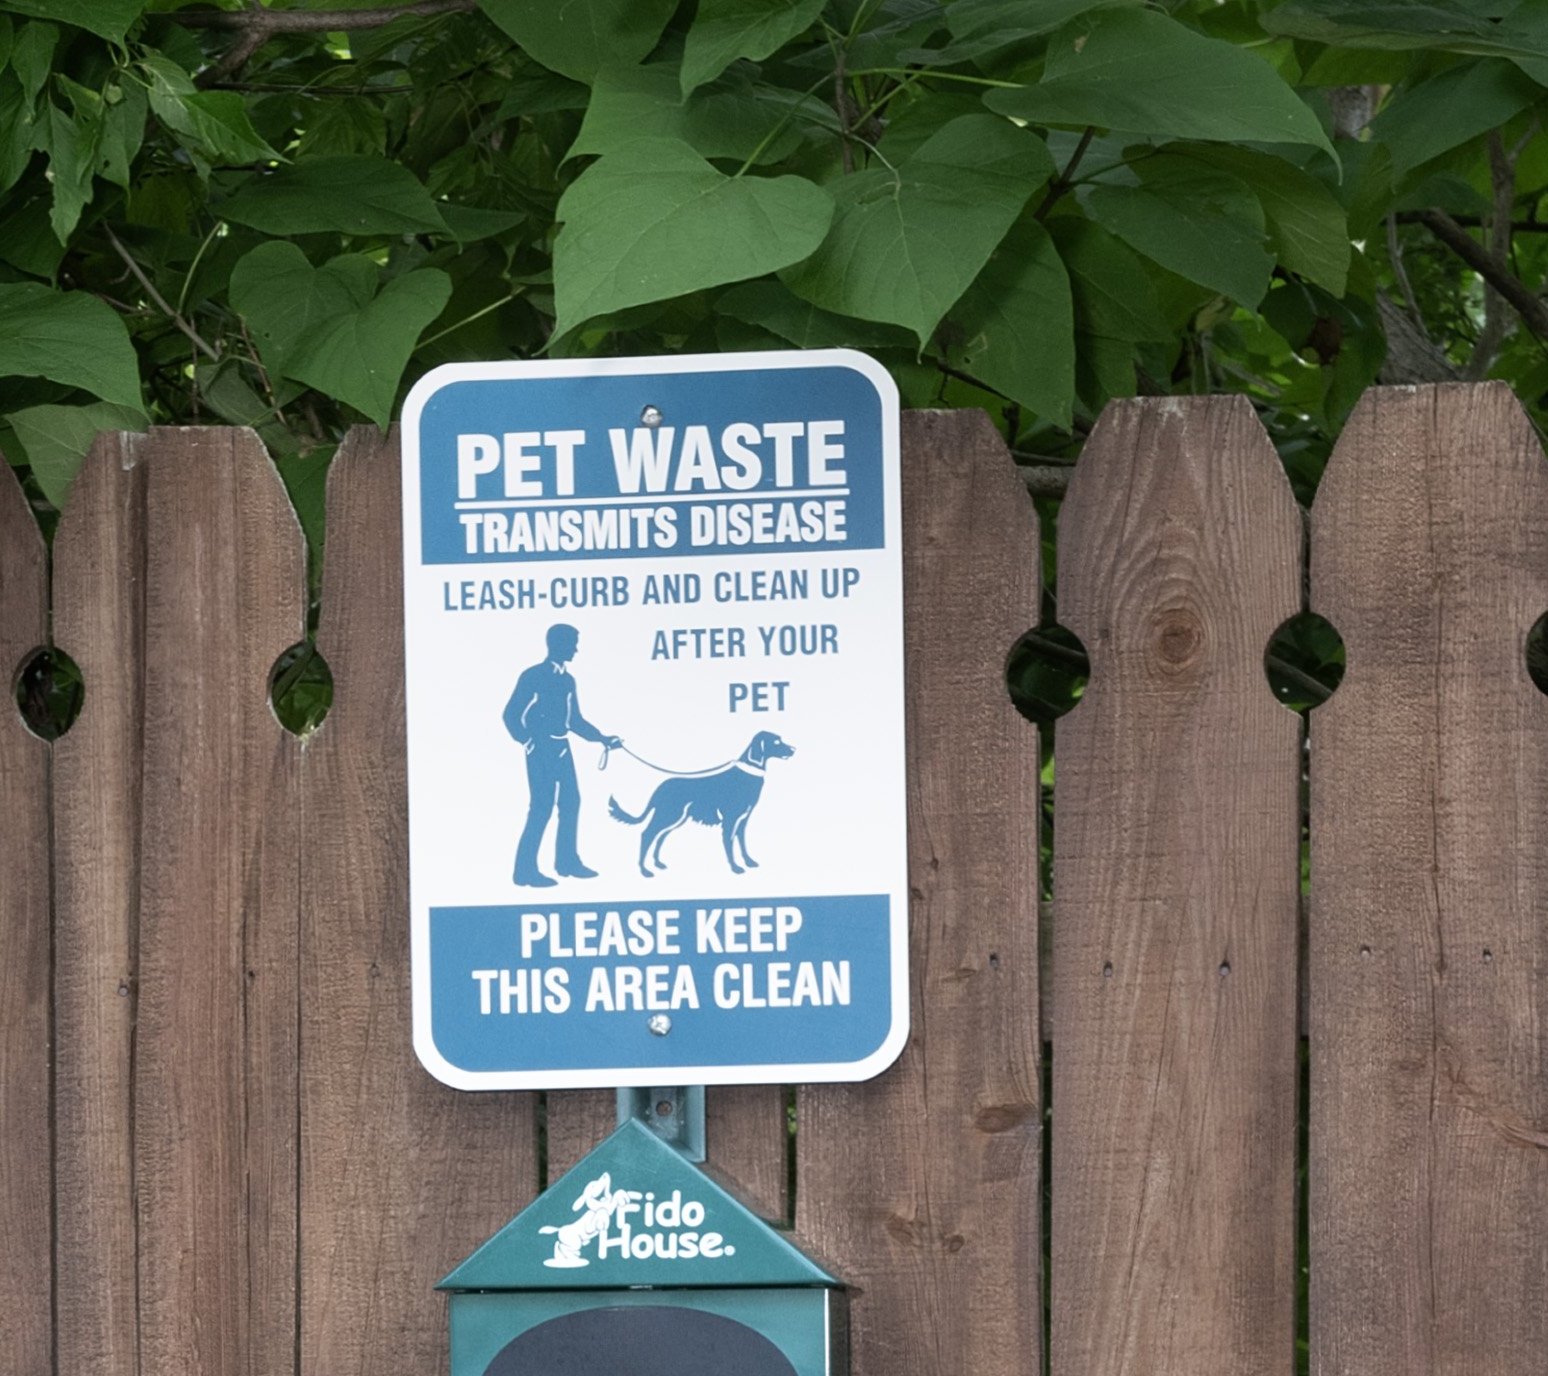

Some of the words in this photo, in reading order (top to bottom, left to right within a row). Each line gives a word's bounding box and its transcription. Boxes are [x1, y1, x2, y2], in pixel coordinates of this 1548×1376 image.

[457, 430, 586, 499] PET
[609, 421, 848, 494] WASTE
[459, 507, 678, 554] TRANSMITS
[691, 500, 848, 546] DISEASE
[444, 576, 630, 611] LEASH-CURB
[642, 574, 702, 605] AND
[714, 570, 807, 602] CLEAN
[821, 567, 860, 598] UP
[651, 628, 746, 660] AFTER
[758, 624, 839, 656] YOUR
[729, 681, 790, 712] PET
[520, 910, 681, 958] PLEASE
[696, 906, 804, 953] KEEP
[471, 967, 572, 1014] THIS
[585, 964, 700, 1012] AREA
[713, 960, 851, 1007] CLEAN
[616, 1189, 706, 1229] Fido
